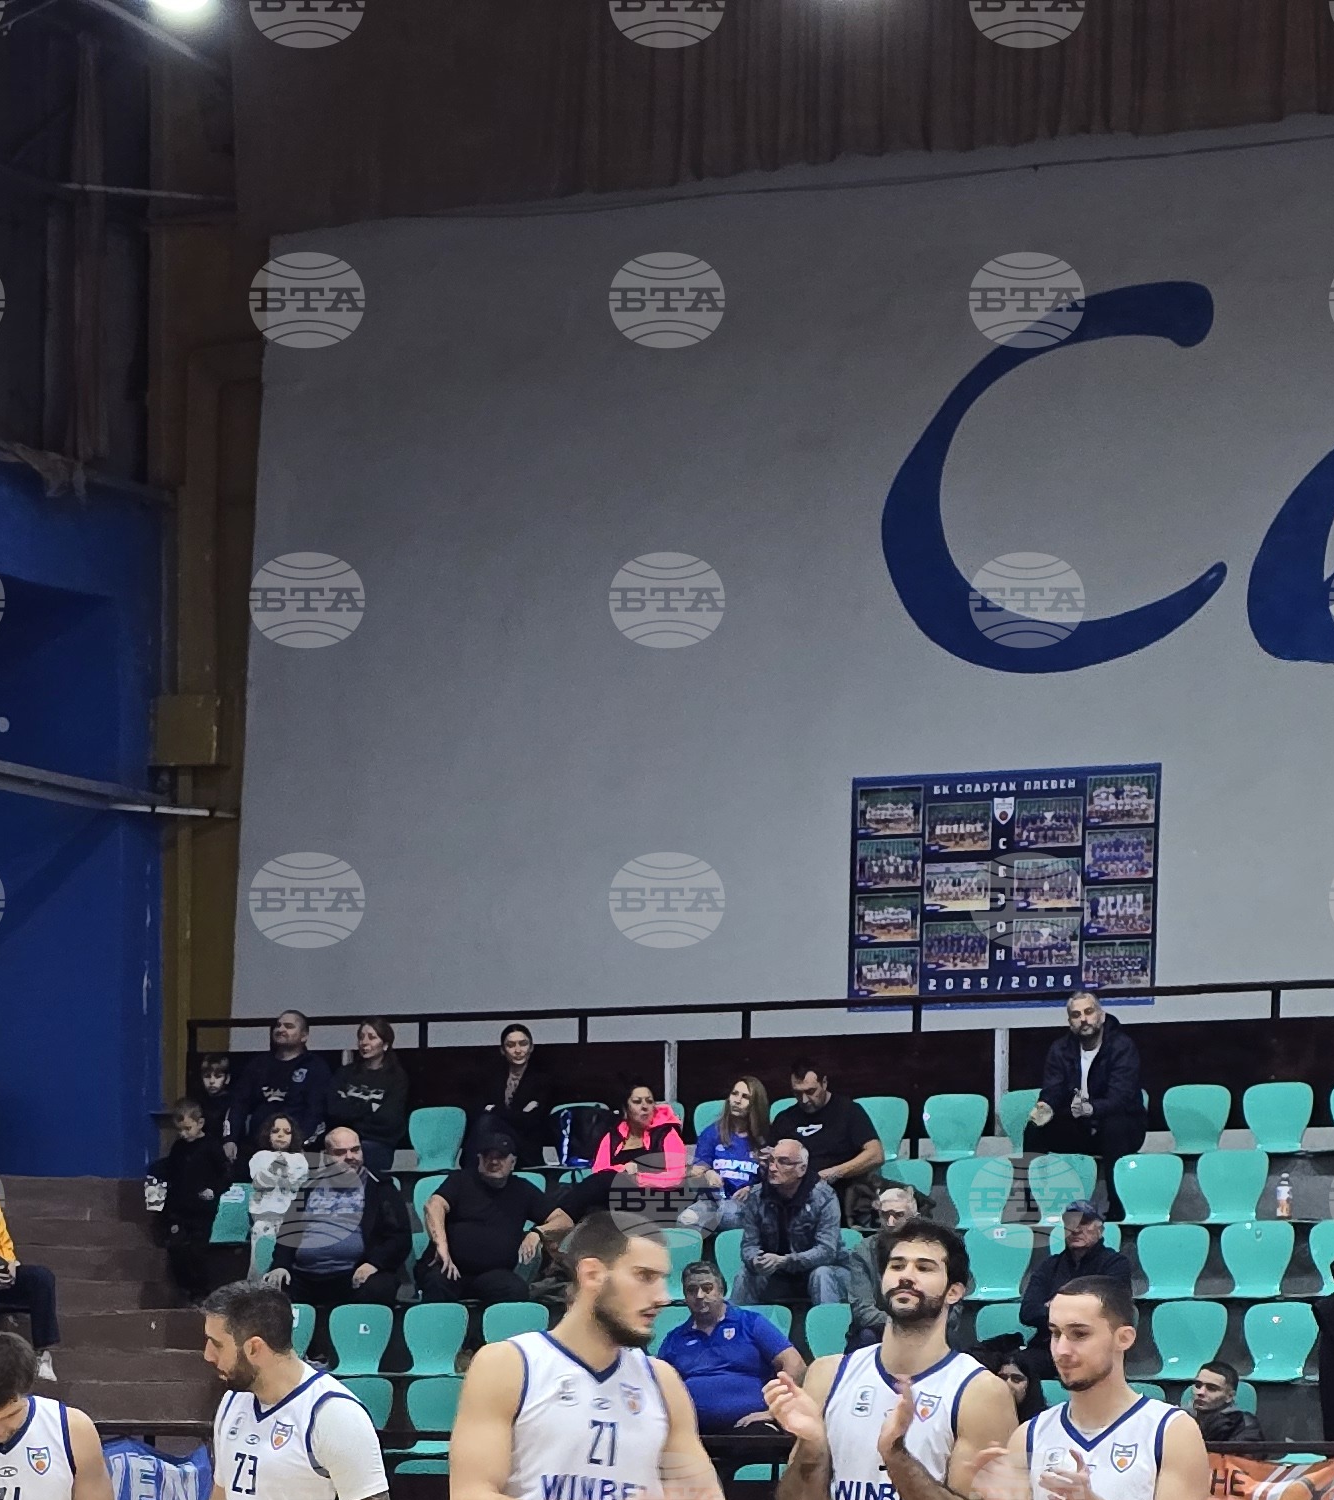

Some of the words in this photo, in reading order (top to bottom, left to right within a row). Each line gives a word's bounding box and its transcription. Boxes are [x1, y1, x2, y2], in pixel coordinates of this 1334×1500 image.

[956, 780, 1017, 794] СПАРТАК
[587, 1419, 618, 1467] 21
[231, 1451, 259, 1496] 23
